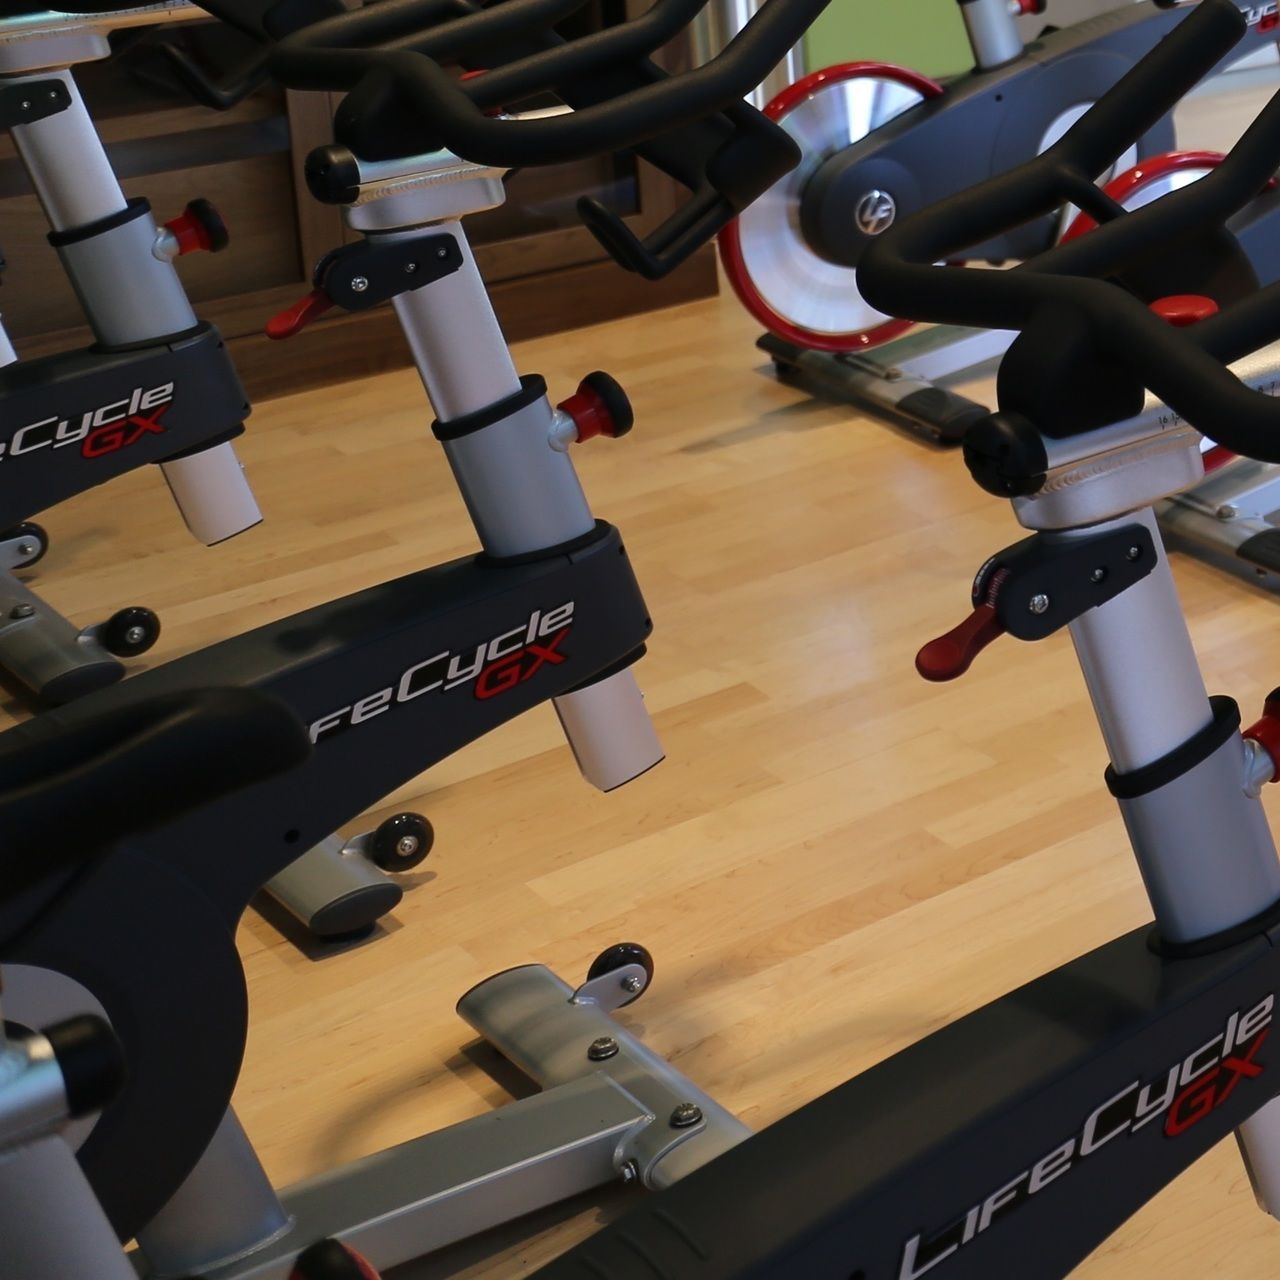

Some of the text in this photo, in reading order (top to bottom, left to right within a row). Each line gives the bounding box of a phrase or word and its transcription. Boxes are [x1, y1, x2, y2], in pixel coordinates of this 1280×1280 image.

[81, 406, 168, 459] GX
[474, 628, 570, 700] GX
[1163, 1028, 1271, 1137] GX
